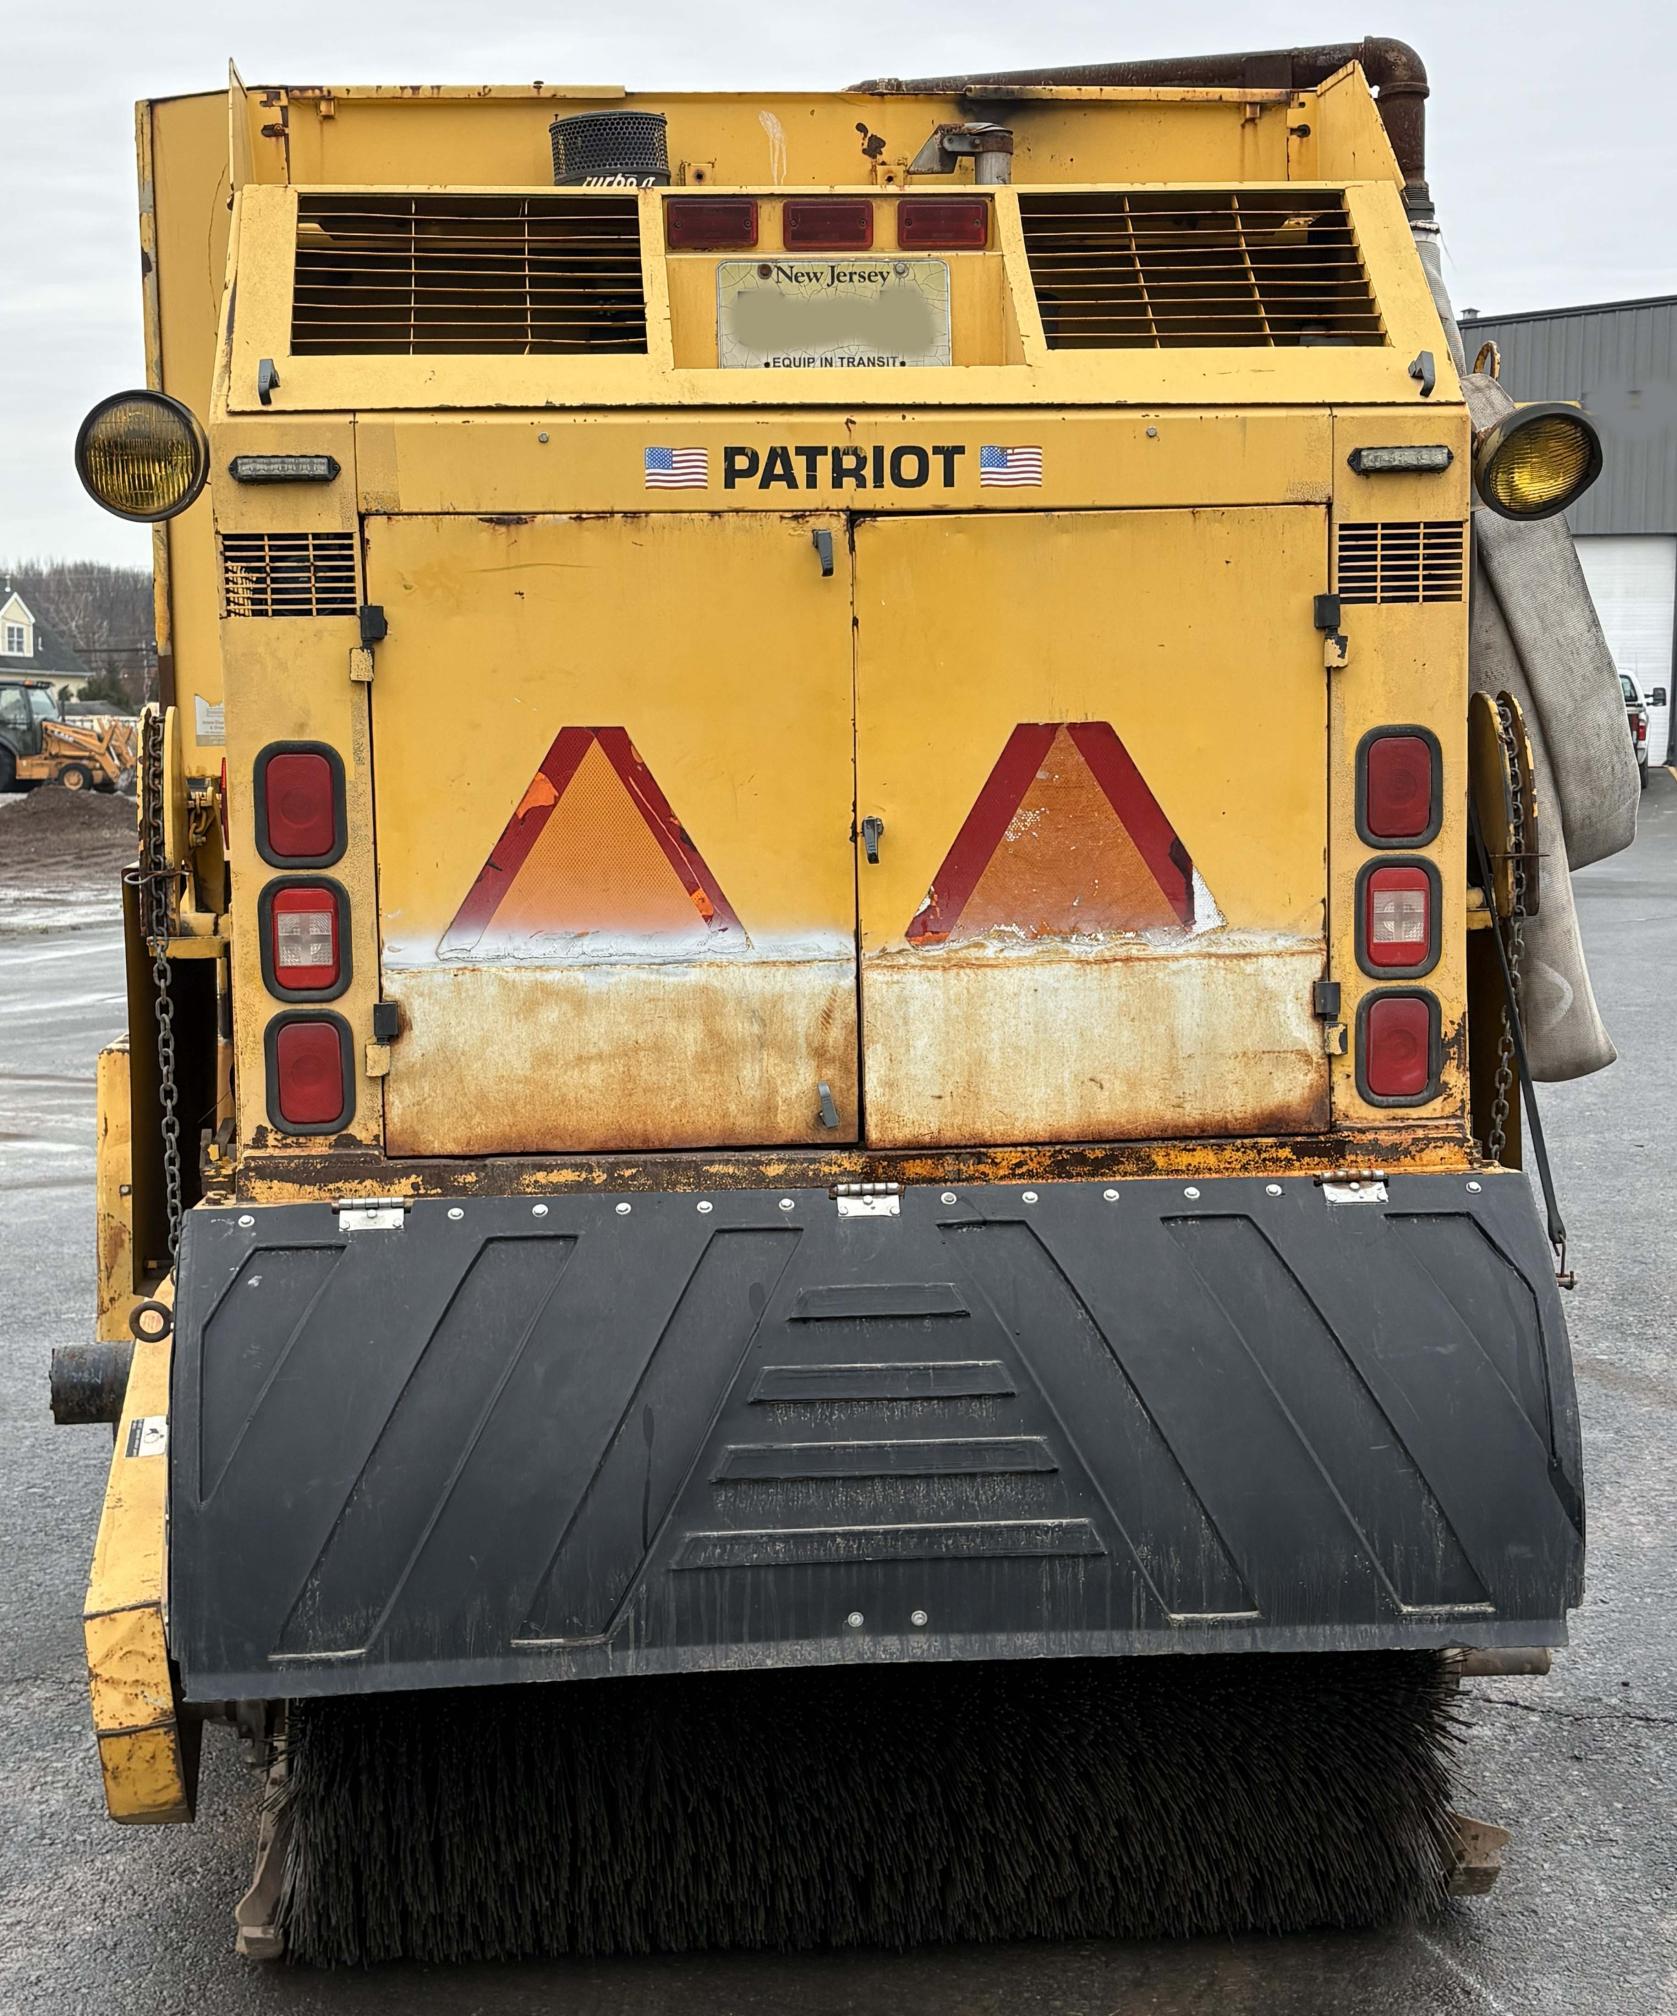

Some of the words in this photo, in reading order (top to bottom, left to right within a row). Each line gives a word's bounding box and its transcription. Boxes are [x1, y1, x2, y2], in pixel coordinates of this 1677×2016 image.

[774, 265, 824, 284] New
[827, 264, 890, 288] Jersey
[772, 357, 816, 368] EQUIP
[820, 357, 830, 368] IN
[840, 356, 898, 368] TRANSIT
[723, 445, 965, 490] PATRIOT
